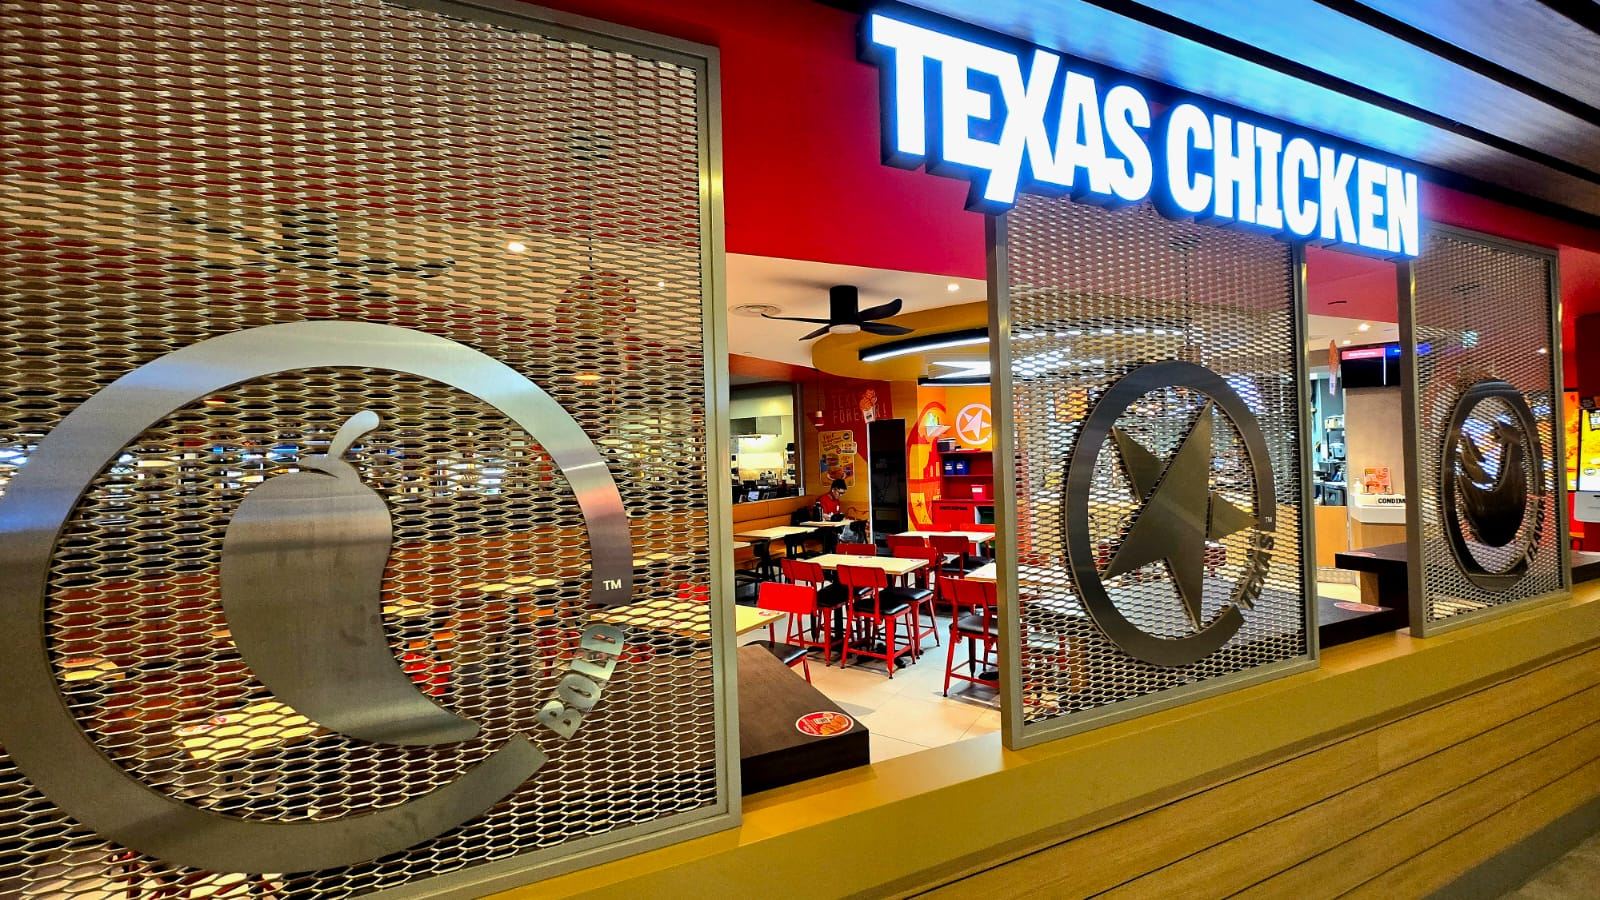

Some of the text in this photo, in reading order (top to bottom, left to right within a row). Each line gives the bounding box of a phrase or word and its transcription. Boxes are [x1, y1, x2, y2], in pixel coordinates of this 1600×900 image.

[872, 14, 1419, 256] TEXAS CHICKEN
[603, 579, 622, 590] TM
[536, 624, 624, 740] BOLD
